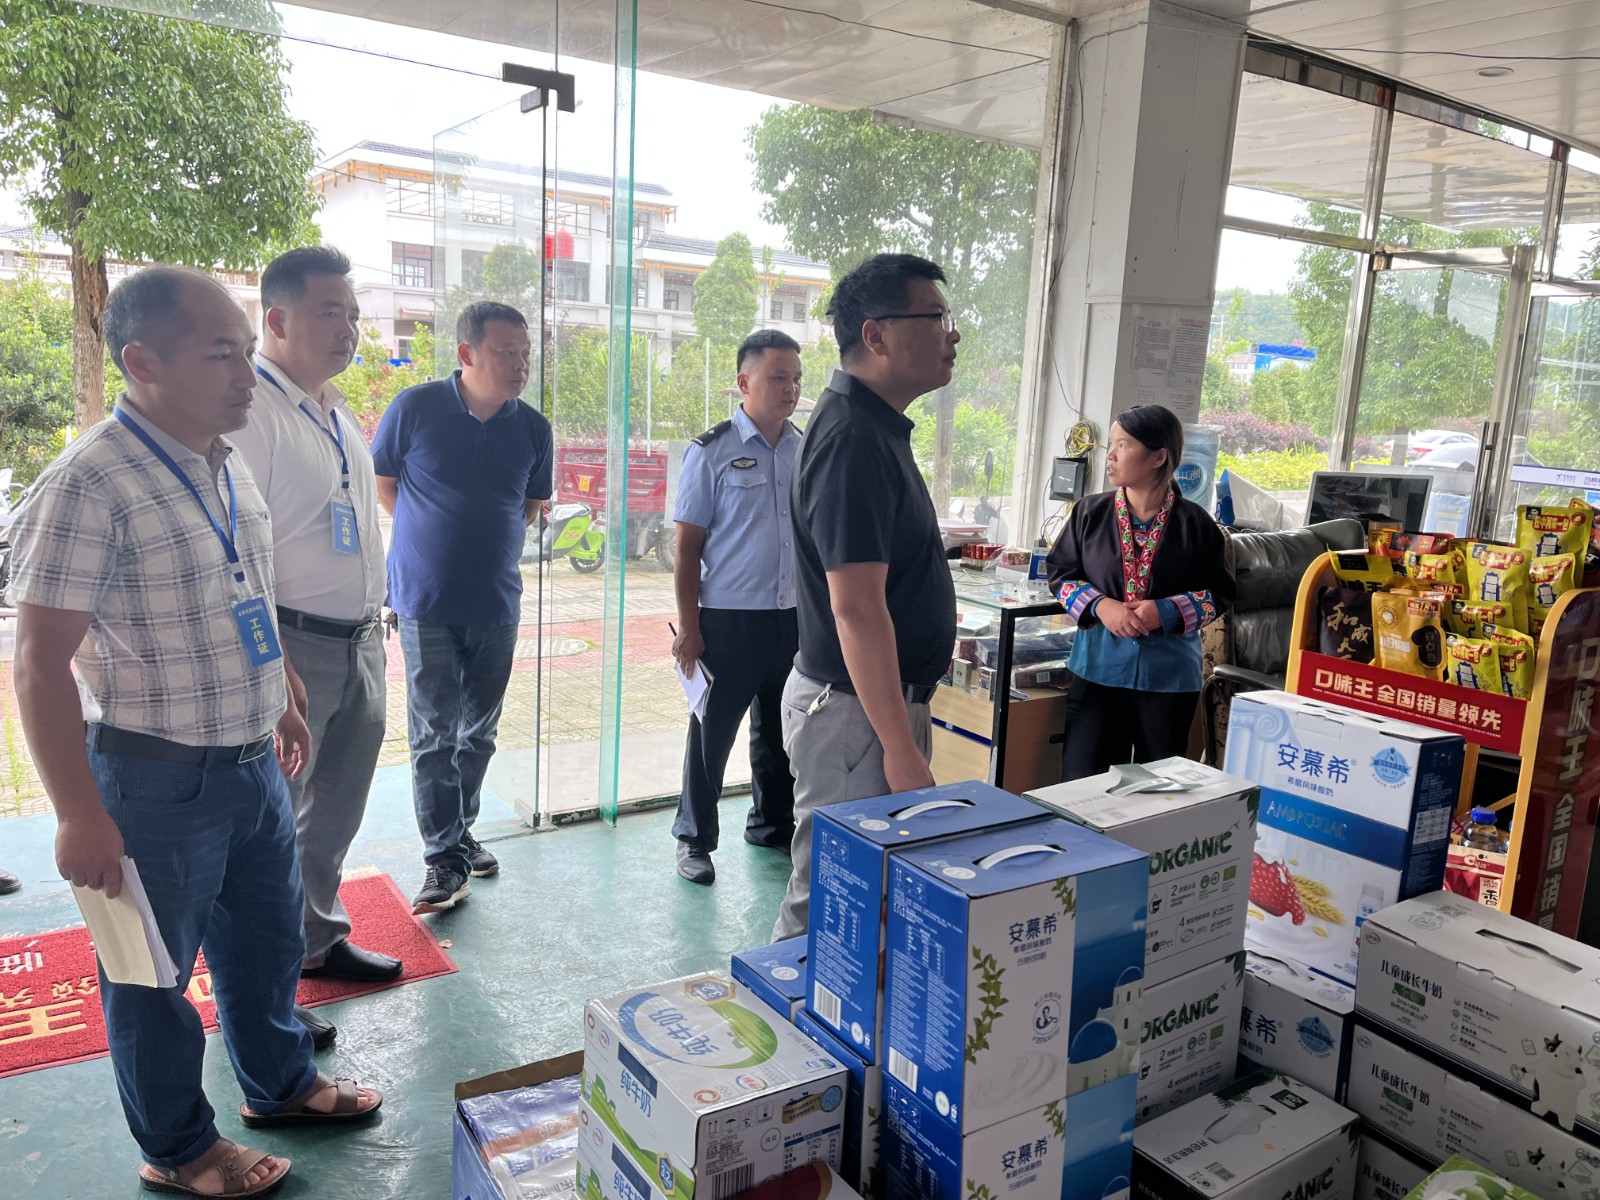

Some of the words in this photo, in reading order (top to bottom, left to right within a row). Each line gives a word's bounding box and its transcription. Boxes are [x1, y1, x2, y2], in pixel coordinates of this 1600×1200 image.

[342, 516, 352, 547] 工作证
[249, 617, 270, 655] 工作证
[1315, 668, 1374, 699] 口味王
[1376, 684, 1502, 732] 全国销量领先
[1559, 637, 1600, 780] 口味王
[1278, 743, 1350, 784] 安慕希
[1288, 776, 1334, 797] 希腊风味酸奶
[1150, 830, 1233, 876] ORGANIC
[1009, 913, 1057, 945] 安慕希
[1381, 959, 1443, 999] 儿童成长牛奶
[648, 1007, 720, 1056] 纯牛奶
[620, 1068, 652, 1118] 纯牛奶
[1371, 1063, 1430, 1106] 儿童成长牛奶
[1001, 1137, 1048, 1172] 安慕希
